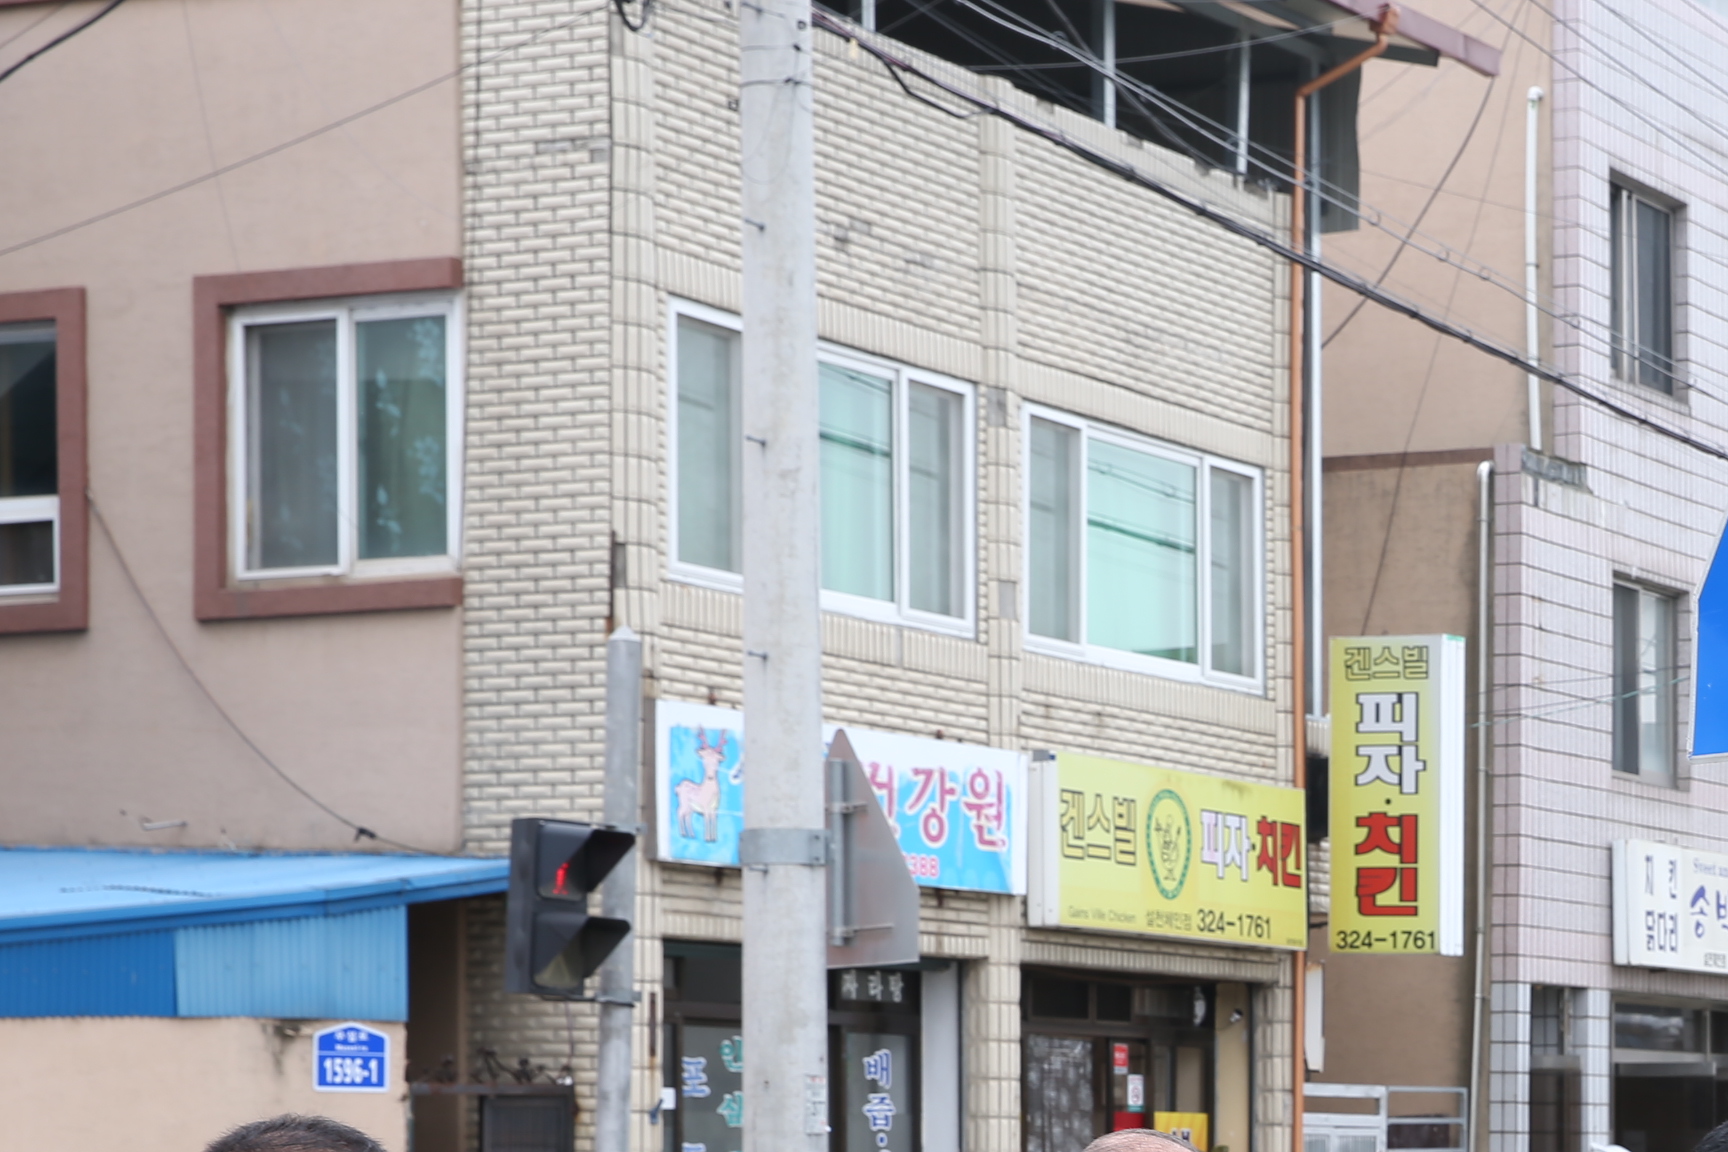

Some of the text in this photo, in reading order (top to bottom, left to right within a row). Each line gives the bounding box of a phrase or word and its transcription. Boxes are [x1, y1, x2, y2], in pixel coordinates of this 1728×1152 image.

[1344, 646, 1429, 681] 겐스빌
[1060, 788, 1137, 866] 겐스빌
[1197, 909, 1271, 939] 324-1761
[1336, 930, 1436, 950] 324-1761
[323, 1057, 378, 1085] 1596-1
